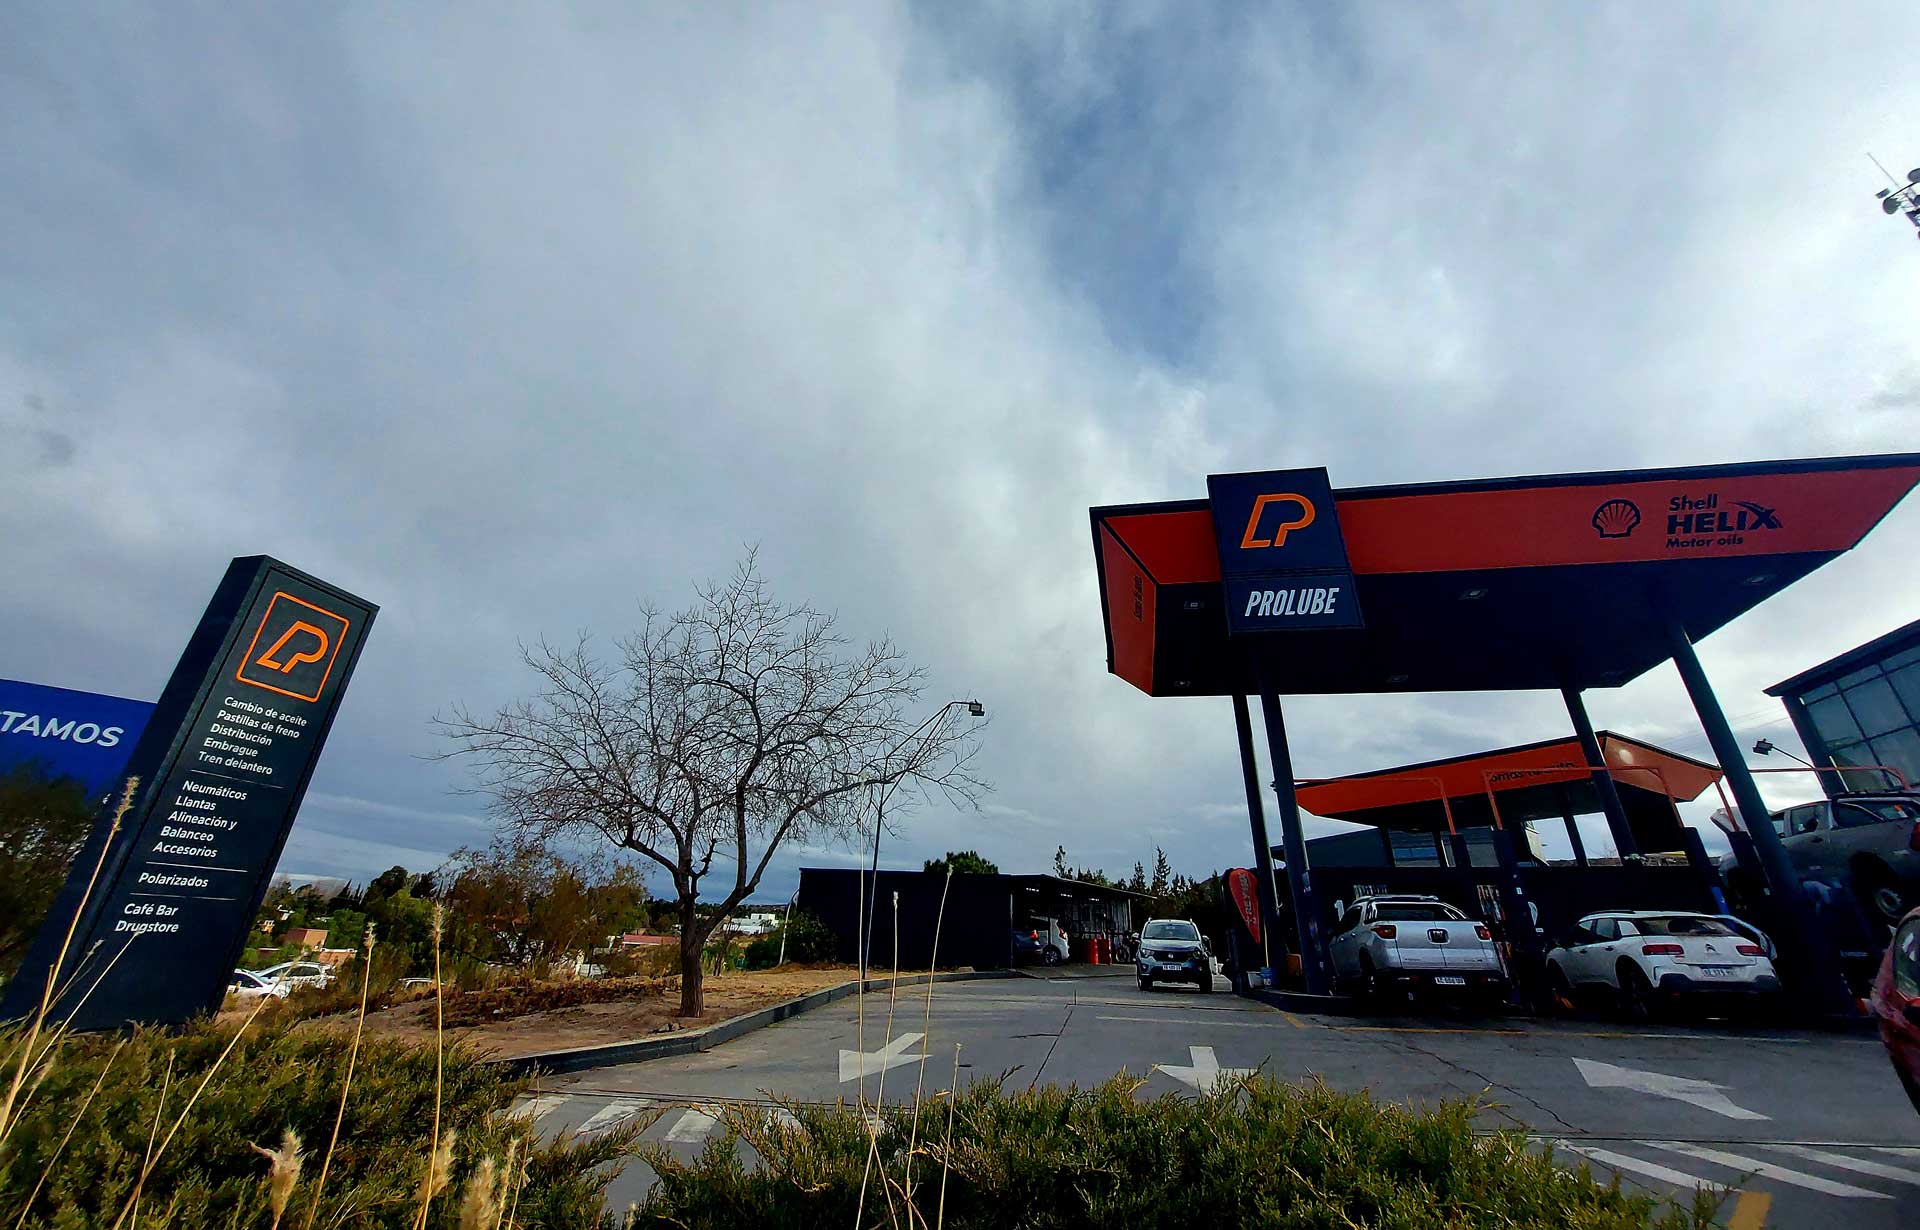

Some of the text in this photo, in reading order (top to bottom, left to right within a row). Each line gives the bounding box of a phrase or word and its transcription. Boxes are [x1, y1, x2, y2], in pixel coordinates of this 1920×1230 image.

[1669, 493, 1718, 512] Shell
[1667, 500, 1783, 534] HELIX
[1666, 534, 1744, 548] Motor oils
[1244, 587, 1340, 617] PROLUBE
[224, 696, 307, 727] Cambio de aceite
[0, 710, 125, 747] TAMOS
[210, 723, 273, 746] Distribución
[216, 710, 300, 739] Pastillas de freno
[203, 737, 259, 757] Embrague
[198, 751, 273, 775] Tren delantero
[182, 780, 248, 800] Neumáticos
[175, 795, 217, 811] Llantas
[168, 810, 238, 831] Alineación y
[160, 826, 214, 842] Balanceo
[152, 841, 218, 858] Accesorios
[138, 872, 209, 888] Polarizados
[124, 903, 179, 916] Café Bar
[114, 920, 179, 934] Drugstore
